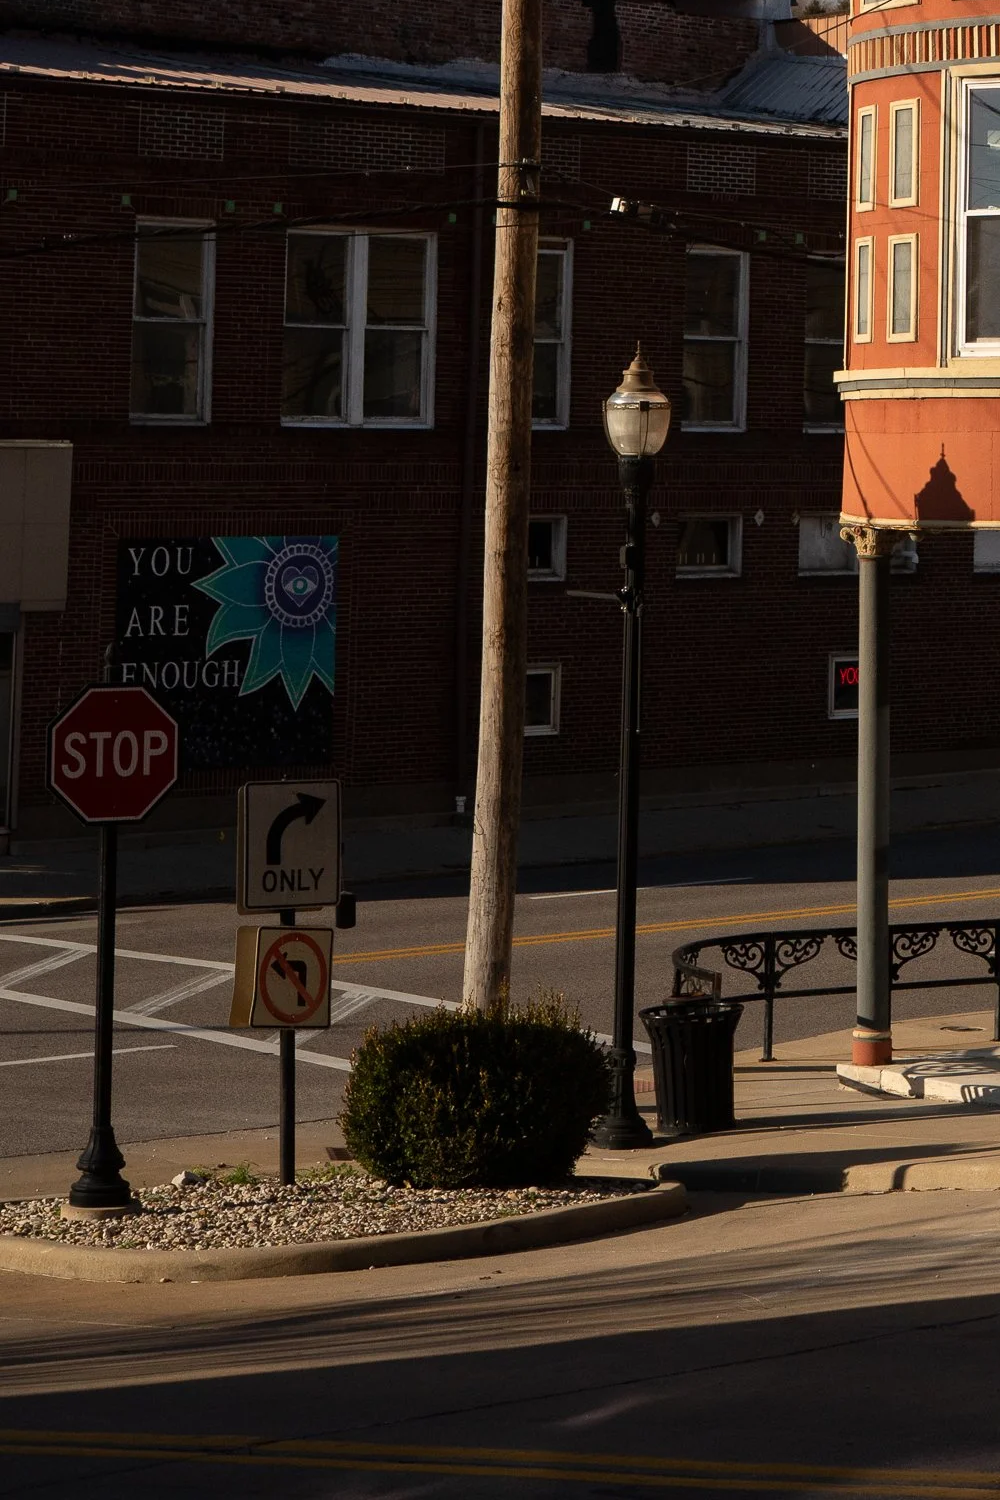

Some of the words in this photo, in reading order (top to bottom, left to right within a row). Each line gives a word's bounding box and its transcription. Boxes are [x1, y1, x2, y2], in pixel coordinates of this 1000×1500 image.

[127, 545, 194, 577] YOU
[124, 604, 191, 638] ARE
[121, 659, 242, 690] ENOUGH
[60, 729, 169, 780] STOP
[262, 867, 325, 894] ONLY
